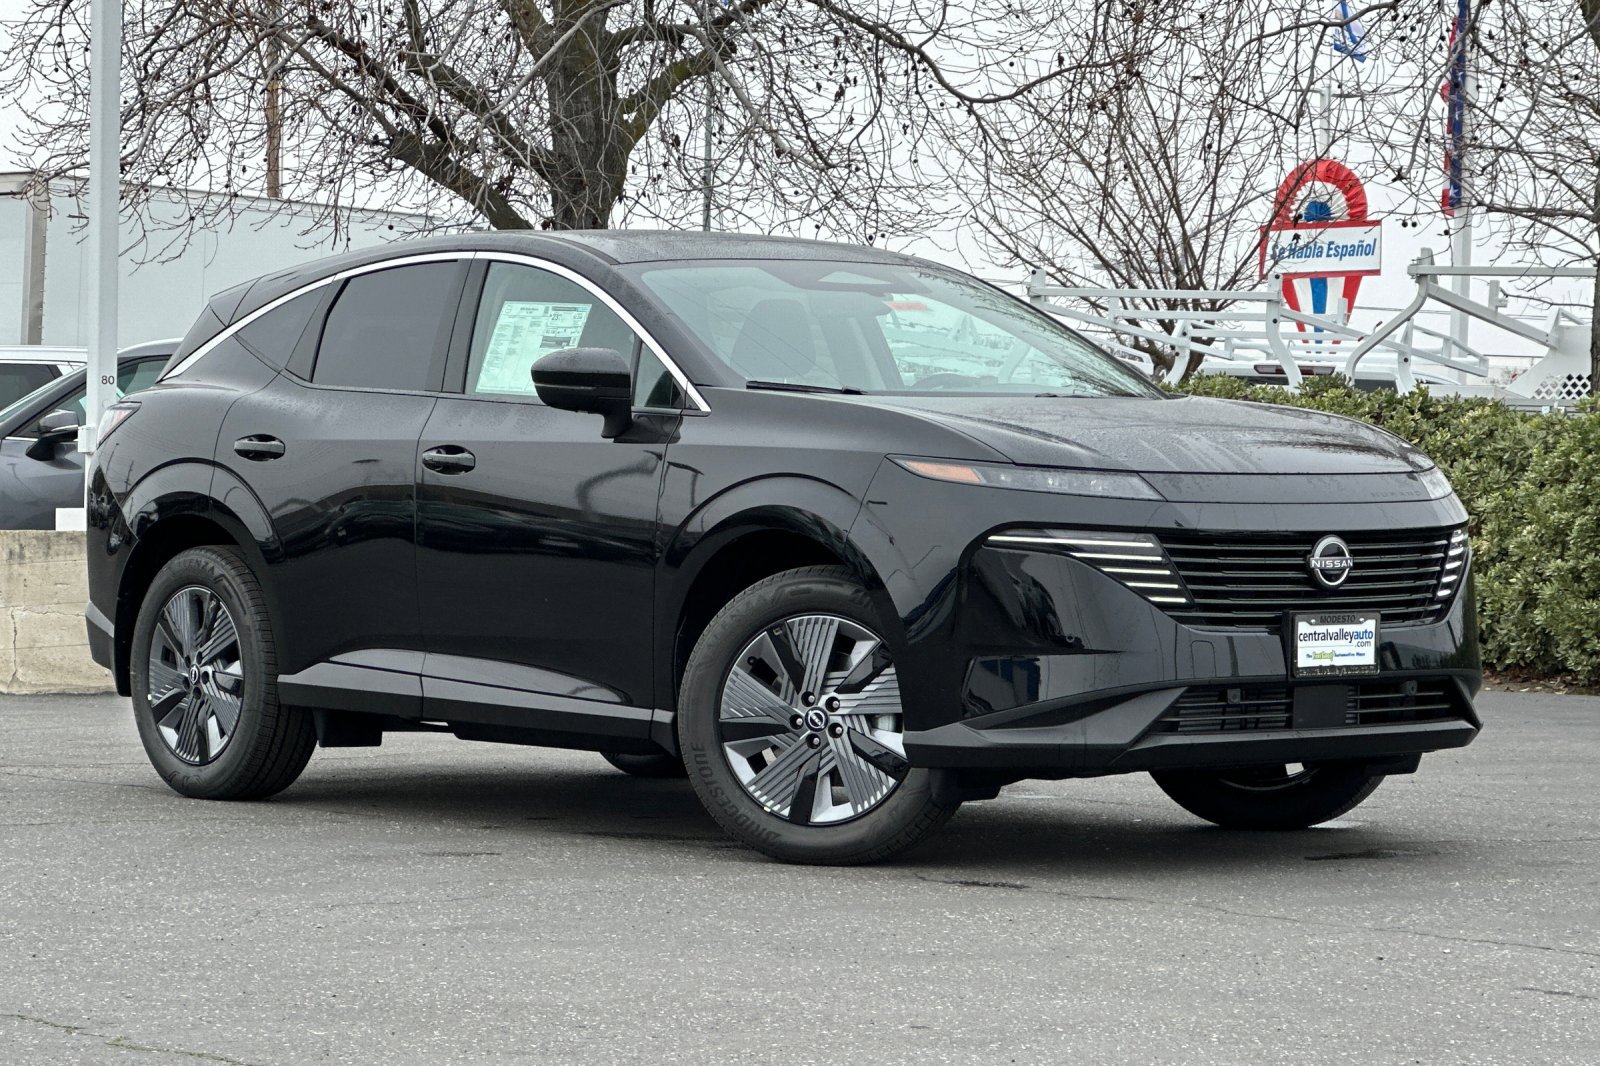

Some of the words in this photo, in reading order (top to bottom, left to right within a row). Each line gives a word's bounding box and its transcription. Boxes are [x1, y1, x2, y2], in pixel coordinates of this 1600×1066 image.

[1287, 241, 1323, 259] Habla
[1325, 238, 1377, 261] Español
[101, 375, 115, 385] 80
[1311, 559, 1353, 568] NISSAN
[1320, 614, 1356, 624] MODESTO
[1299, 628, 1374, 644] centralvalleyauto
[1355, 640, 1371, 648] .com
[691, 741, 782, 841] BRIDGESTONE
